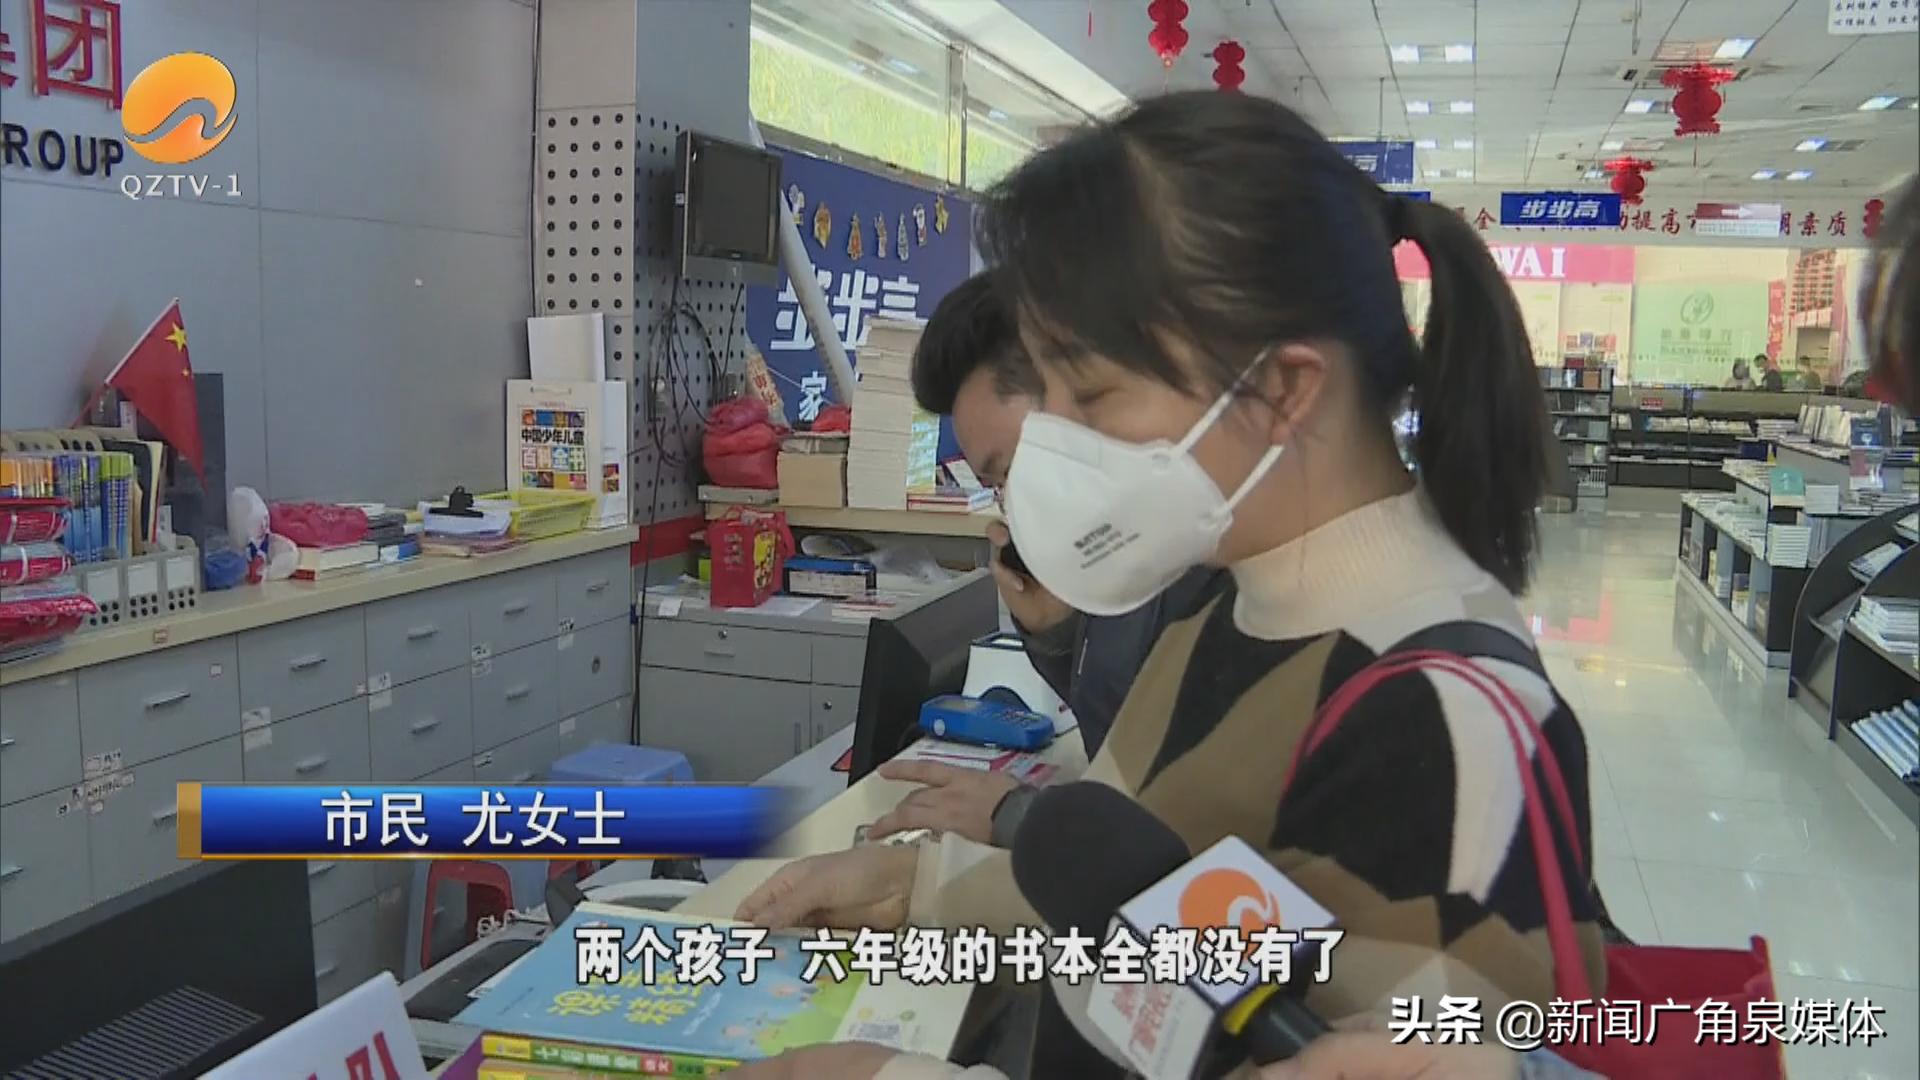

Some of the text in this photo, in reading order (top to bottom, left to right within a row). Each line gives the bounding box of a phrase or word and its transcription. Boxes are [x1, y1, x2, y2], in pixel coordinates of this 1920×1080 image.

[1, 0, 122, 110] 团
[1519, 199, 1602, 219] 步步高
[521, 428, 585, 446] 中国少年儿童
